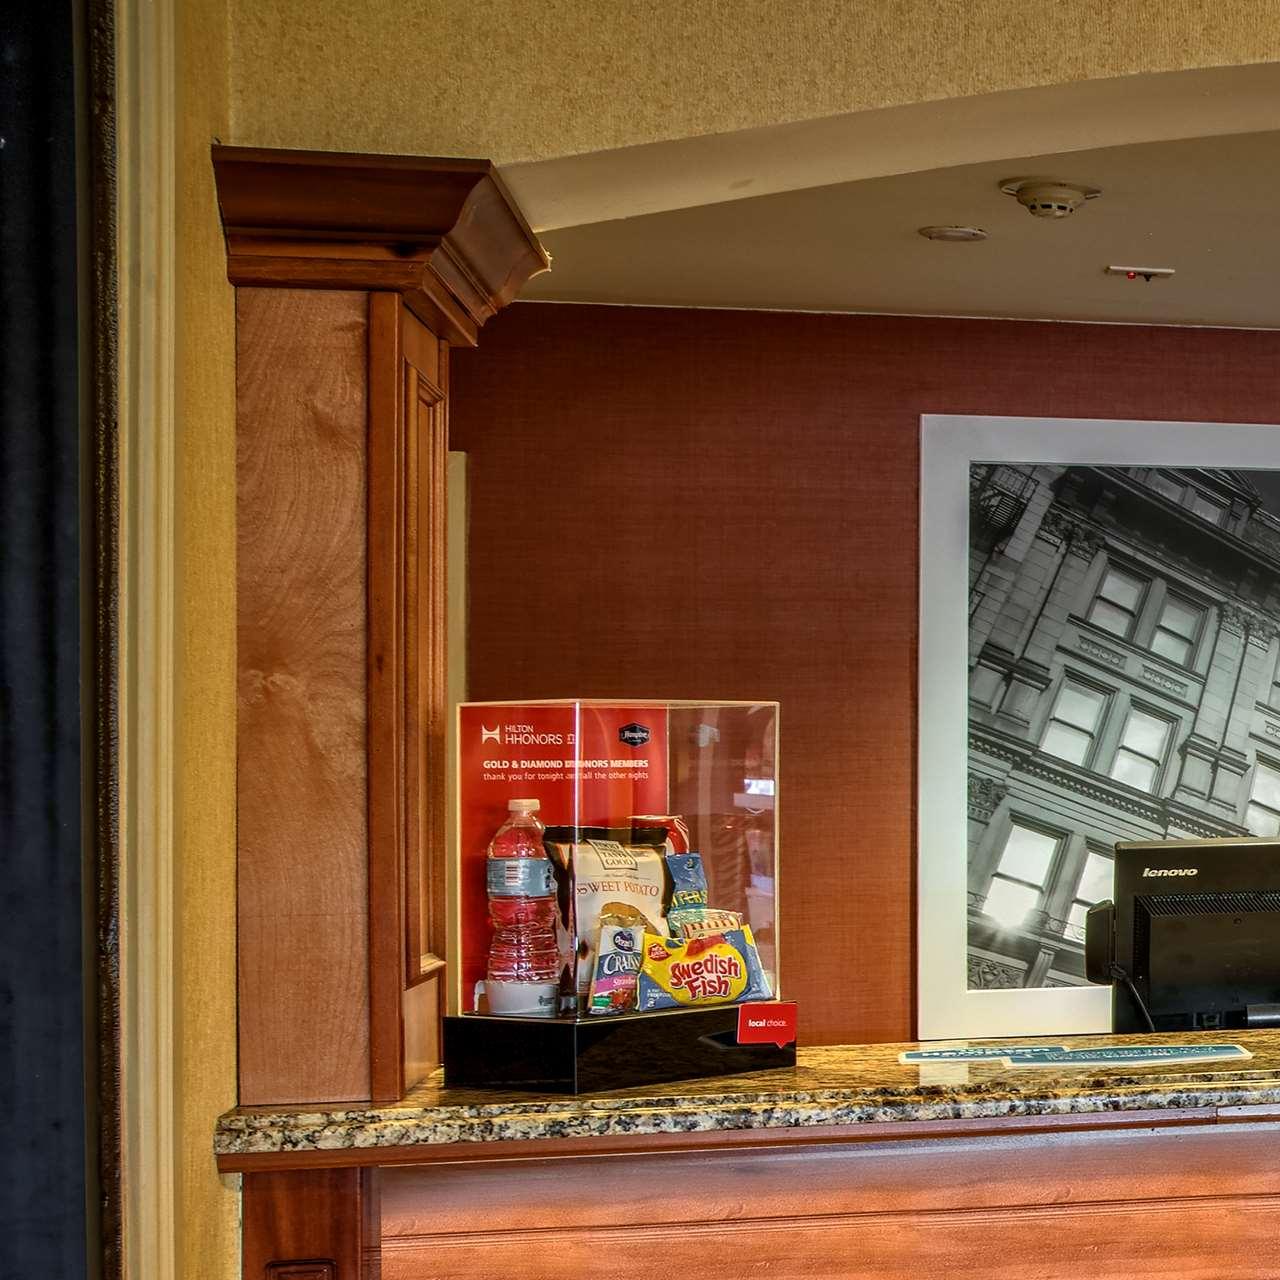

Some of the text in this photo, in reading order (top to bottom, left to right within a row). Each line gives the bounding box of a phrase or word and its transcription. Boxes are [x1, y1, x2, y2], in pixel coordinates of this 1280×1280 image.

[505, 724, 534, 733] HILTON
[505, 733, 563, 745] HHONORS
[483, 759, 509, 769] GOLD
[511, 760, 519, 769] &
[520, 759, 563, 769] DIAMOND
[610, 760, 649, 768] MEMBERS
[483, 772, 506, 780] thank
[508, 773, 522, 782] you
[524, 771, 536, 780] for
[538, 772, 564, 781] tonight
[583, 771, 593, 779] all
[594, 771, 608, 779] the
[608, 771, 627, 779] other
[628, 771, 649, 781] nights
[1142, 867, 1198, 877] lenovo
[624, 881, 660, 897] POTATO
[670, 953, 740, 987] Swedish
[684, 976, 730, 999] Fish
[748, 1019, 766, 1027] local
